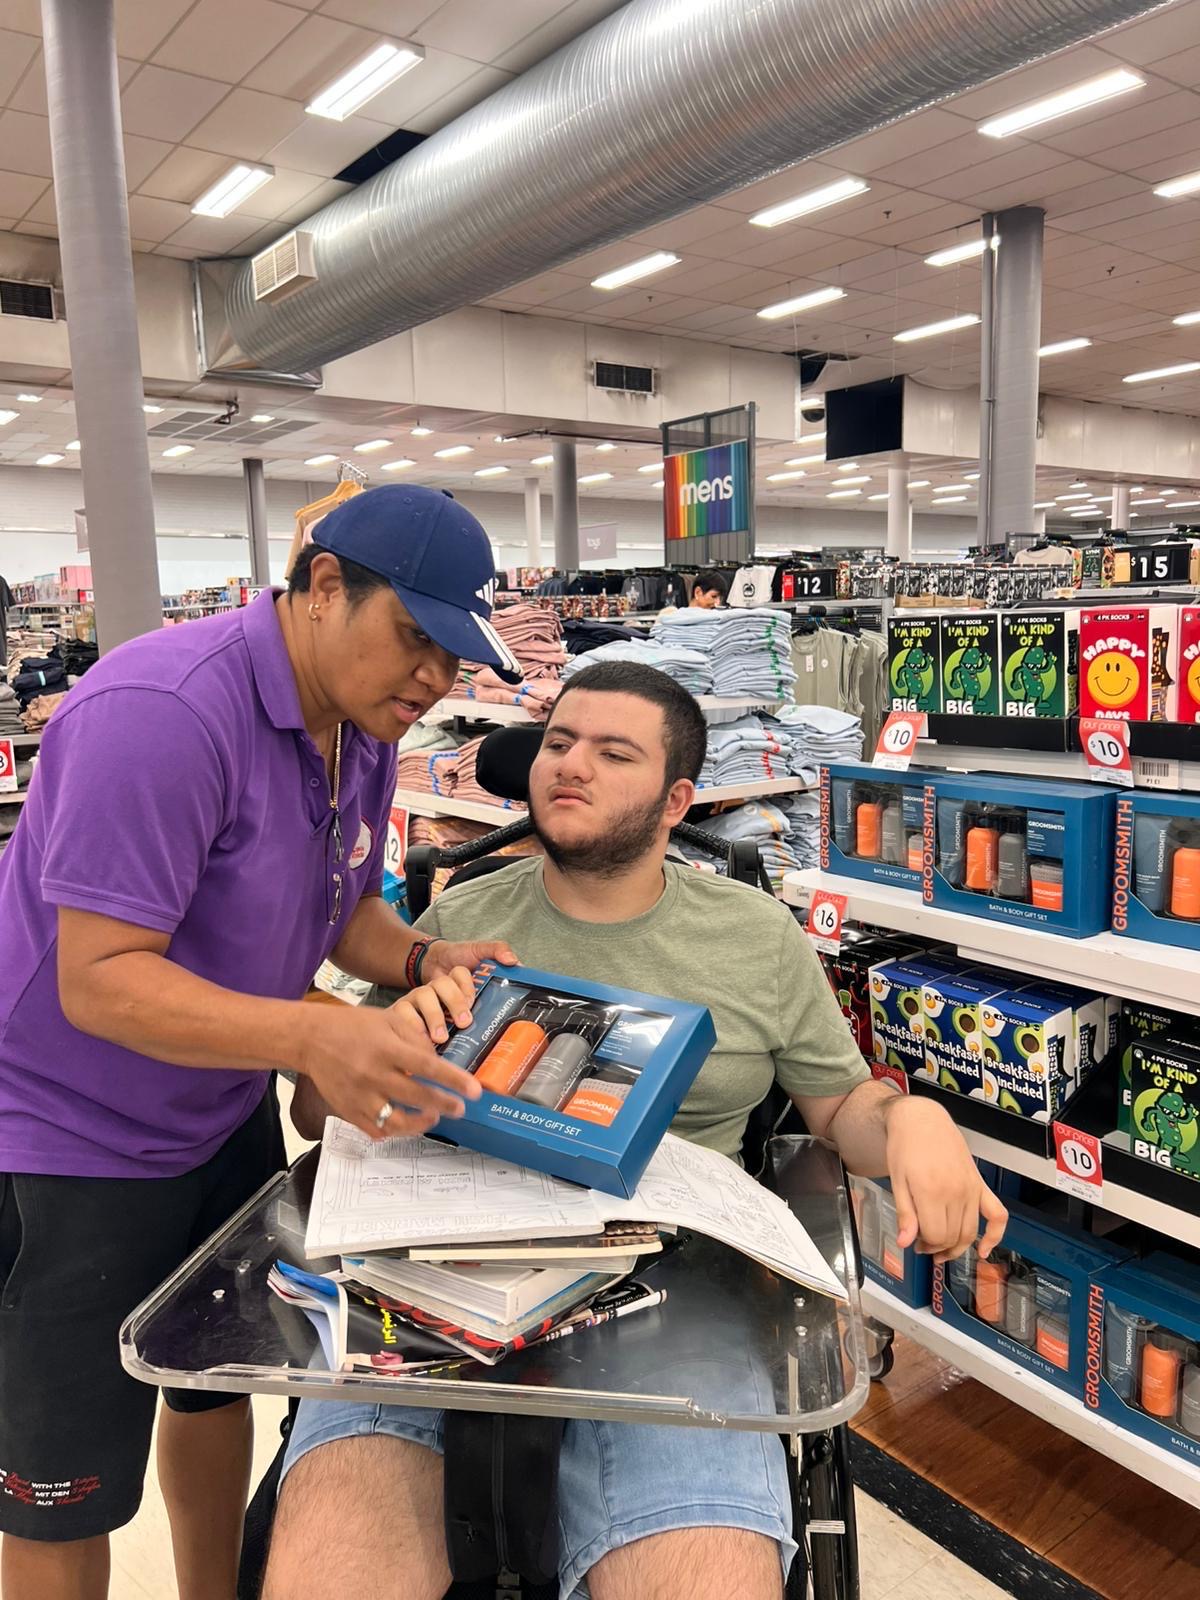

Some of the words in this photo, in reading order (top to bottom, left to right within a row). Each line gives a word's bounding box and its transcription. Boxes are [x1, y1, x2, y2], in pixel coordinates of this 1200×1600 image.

[680, 475, 734, 507] mens
[1131, 556, 1168, 578] $15
[798, 577, 821, 595] $12
[895, 627, 909, 638] I'M
[911, 627, 932, 637] KIND
[948, 626, 964, 637] I'M
[966, 625, 989, 636] KIND
[1010, 624, 1027, 635] I'M
[1030, 623, 1055, 635] KIND
[903, 638, 914, 647] OF
[916, 638, 923, 647] A
[957, 638, 970, 647] OF
[973, 638, 980, 647] A
[1020, 636, 1033, 646] OF
[1036, 636, 1044, 646] A
[1083, 637, 1145, 661] HAPPY
[892, 698, 918, 713] BIG
[946, 700, 974, 715] BIG
[1006, 701, 1036, 717] BIG
[1083, 721, 1098, 730] our
[1100, 723, 1121, 733] price
[889, 730, 910, 746] $10
[1090, 740, 1120, 757] $10
[821, 767, 830, 869] GROOMSMITH
[1028, 820, 1065, 831] GROOMSMITH
[924, 785, 935, 902] GROOMSMITH
[1157, 829, 1167, 873] GROOMSMITH
[1113, 799, 1133, 932] GROOMSMITH
[816, 910, 835, 928] $16
[988, 903, 1003, 911] BATH
[1008, 908, 1024, 916] BODY
[1024, 911, 1036, 919] GIFT
[482, 997, 516, 1041] GROOMSMITH
[1009, 1018, 1027, 1027] SOCKS
[1152, 1014, 1171, 1024] SOCKS
[876, 1019, 923, 1044] Breakfast
[928, 1036, 980, 1063] Breakfast
[987, 1056, 1043, 1084] Breakfast
[1141, 1059, 1162, 1076] I'M
[1166, 1064, 1198, 1085] KIND
[1166, 1058, 1188, 1070] SOCKS
[1153, 1076, 1170, 1089] OF
[1174, 1083, 1183, 1094] A
[491, 1103, 513, 1116] BATH
[512, 1110, 520, 1119] &
[520, 1112, 545, 1125] BODY
[544, 1120, 566, 1131] GIFT
[564, 1125, 582, 1137] SET
[1057, 1126, 1072, 1137] our
[1072, 1131, 1095, 1146] price
[1063, 1145, 1092, 1171] $10
[1134, 1139, 1173, 1169] BIG
[1086, 1284, 1104, 1409] GROOMSMITH
[1016, 1349, 1031, 1361] BODY
[1031, 1358, 1044, 1368] GIFT
[1171, 1436, 1189, 1450] BATH
